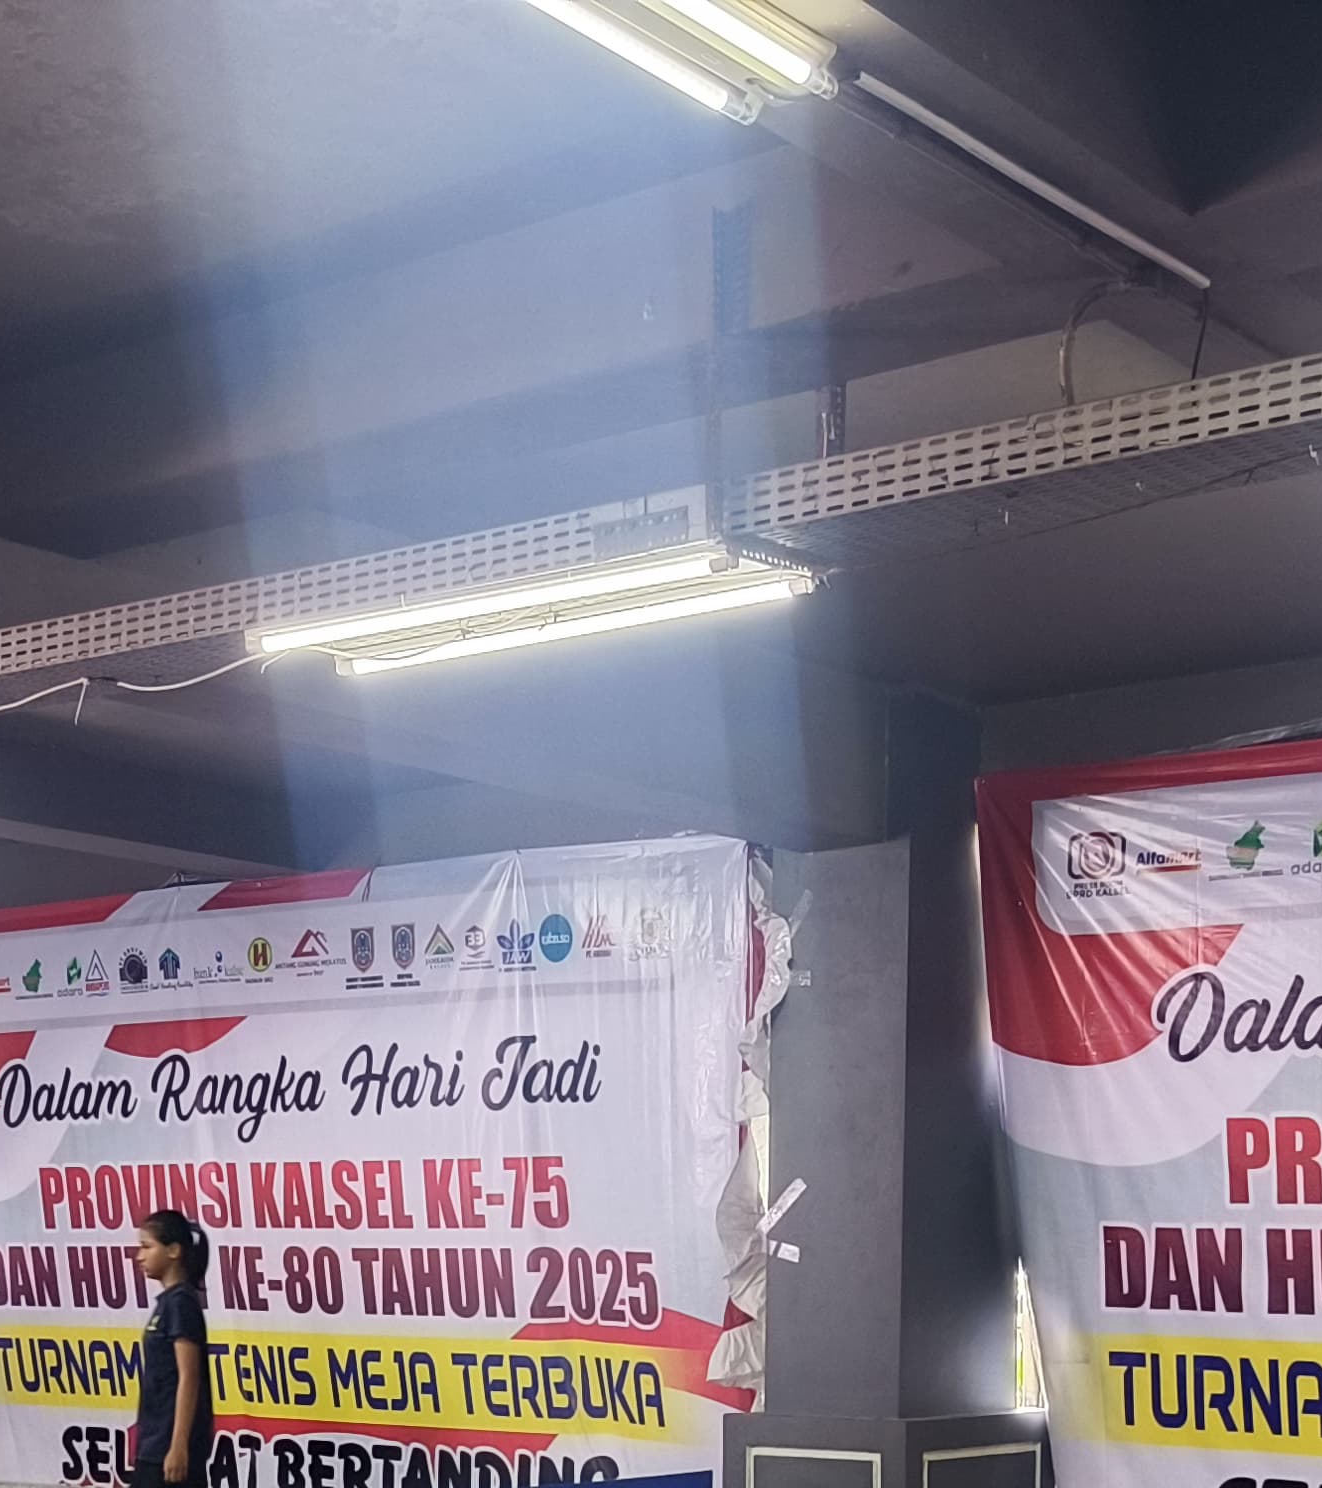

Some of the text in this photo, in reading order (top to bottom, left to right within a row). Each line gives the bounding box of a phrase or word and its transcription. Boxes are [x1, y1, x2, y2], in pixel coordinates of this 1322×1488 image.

[151, 1054, 326, 1143] Rangka
[341, 1042, 465, 1116] Hari
[481, 1034, 602, 1111] Jadi
[39, 1155, 571, 1230] PROVINSI KALSEL KE-75
[67, 1246, 149, 1309] HUT
[218, 1246, 345, 1315] KE-80
[351, 1247, 516, 1319] TAHUN
[527, 1246, 660, 1326] 2025
[1103, 1225, 1243, 1313] DAN
[207, 1343, 317, 1407] TENIS
[327, 1347, 441, 1414] MEJA
[451, 1352, 666, 1428] TERBUKA
